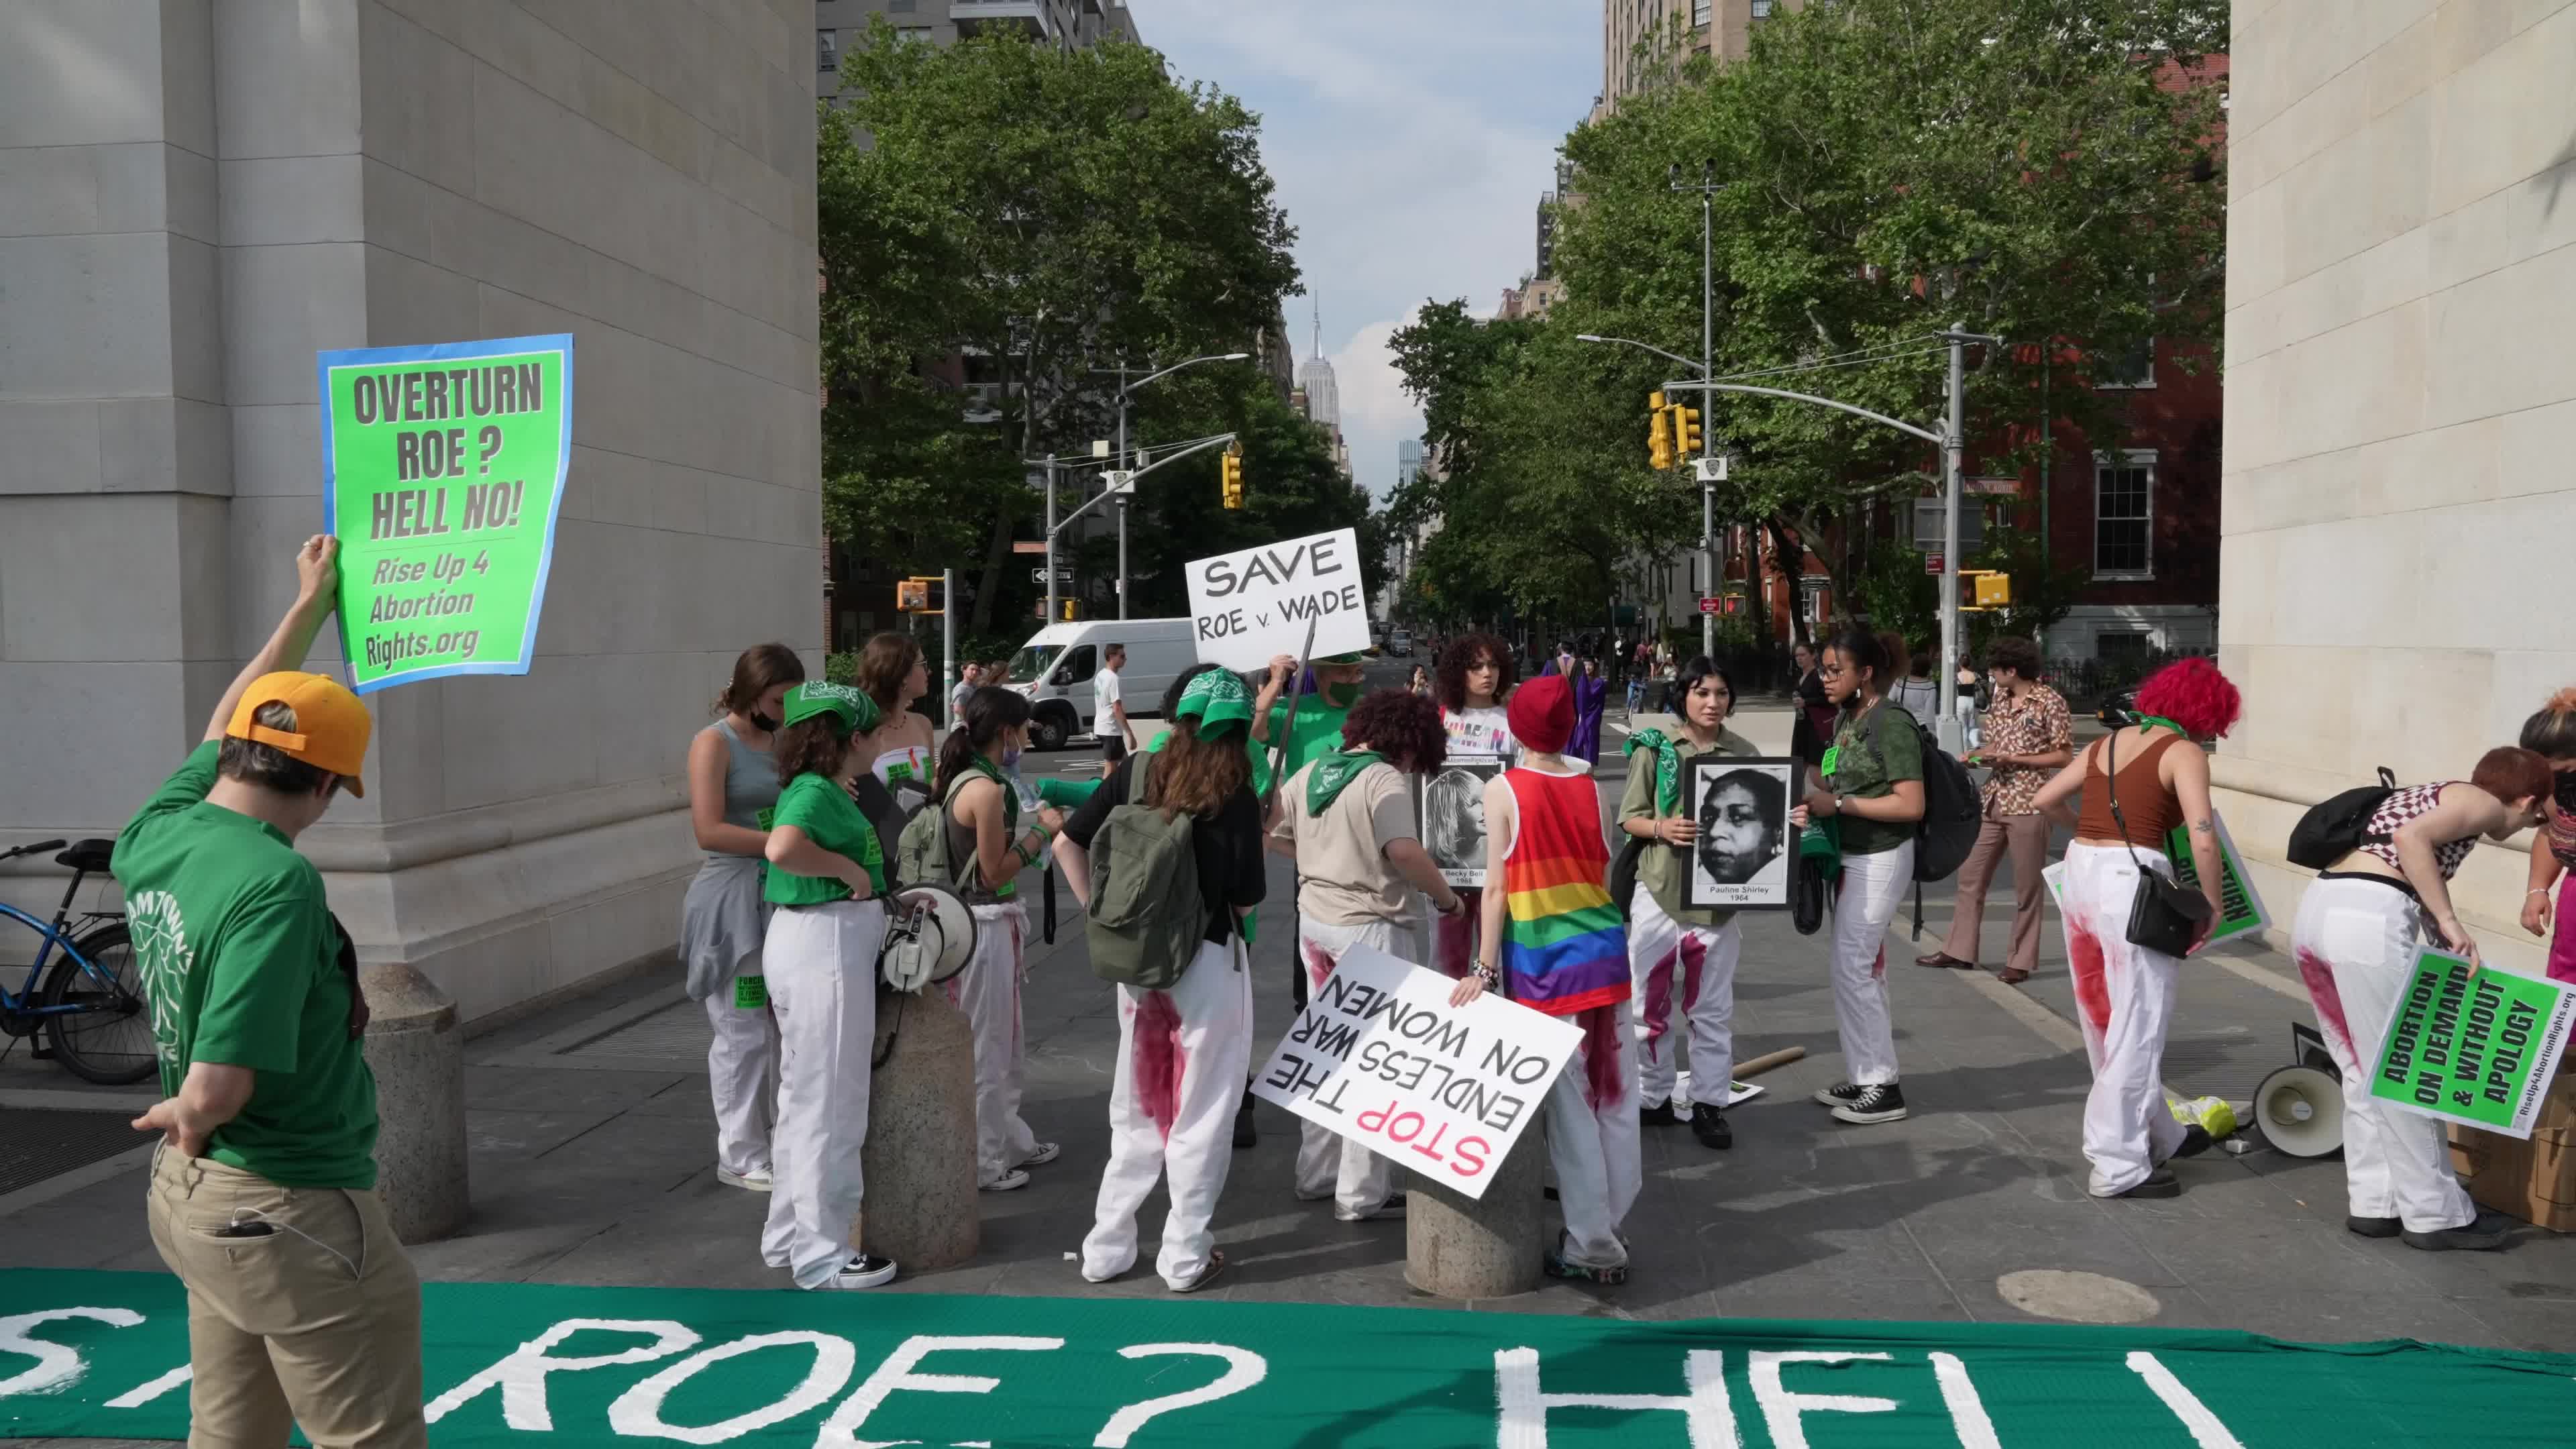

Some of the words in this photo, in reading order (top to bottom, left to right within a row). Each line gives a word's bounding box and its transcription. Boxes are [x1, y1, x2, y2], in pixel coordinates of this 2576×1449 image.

[354, 362, 542, 425] OVERTURN
[370, 487, 450, 540] HELL
[461, 480, 523, 532] NO!
[372, 557, 425, 585] Rise
[433, 553, 466, 584] Up
[472, 549, 489, 575] 4
[1205, 537, 1342, 597] SAVE
[370, 588, 474, 624] Abortion
[1198, 608, 1247, 641] ROE
[1277, 584, 1359, 623] WADE
[366, 629, 479, 671] Rights.org
[1742, 885, 1770, 895] Shirley
[1291, 1008, 1360, 1063] WAR
[1318, 974, 1470, 1058] WOMEN
[2383, 971, 2439, 1084] ABORTION
[2422, 965, 2469, 1067] DEMAND
[2454, 978, 2506, 1081] WITHOUT
[1480, 1038, 1550, 1085] ON
[2483, 999, 2539, 1105] APOLOGY
[2519, 992, 2575, 1116] RiseUp4AbortionRights.org
[1266, 1053, 1350, 1114] THE
[1358, 1040, 1525, 1133] ENDLESS
[2414, 1071, 2444, 1105] ON
[2453, 1090, 2473, 1106] &
[1356, 1100, 1491, 1177] STOP
